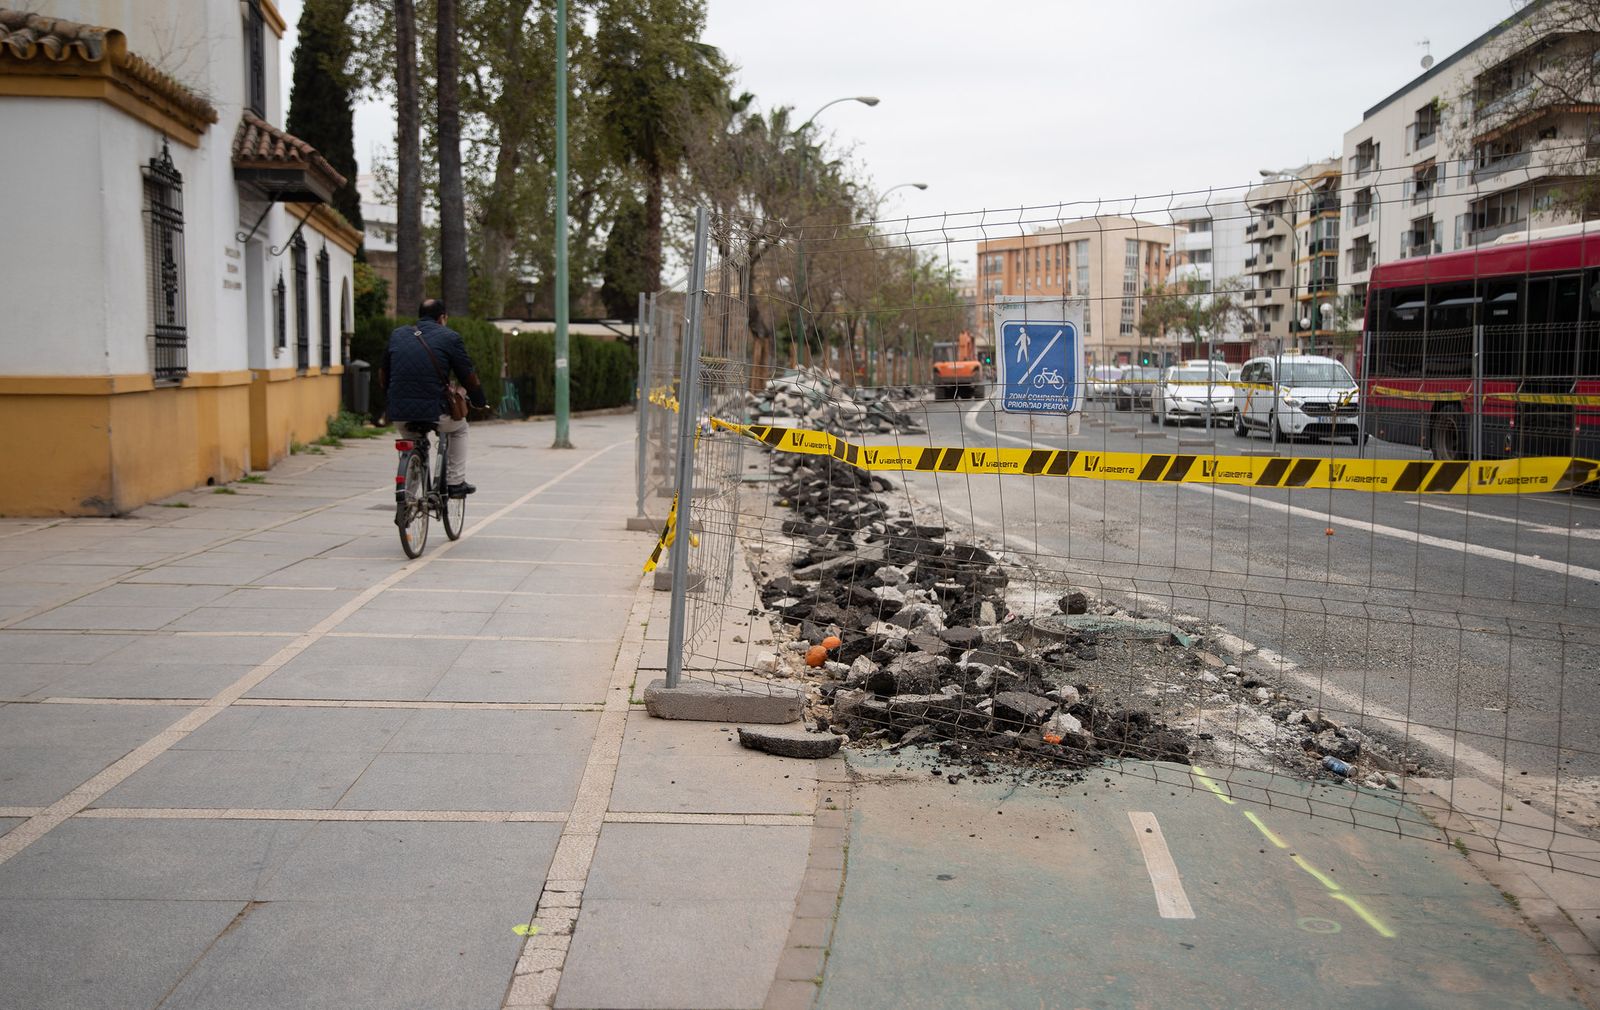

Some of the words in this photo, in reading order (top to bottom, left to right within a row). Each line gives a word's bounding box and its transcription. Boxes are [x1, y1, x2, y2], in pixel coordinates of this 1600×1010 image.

[986, 461, 1018, 469] vialterra
[1099, 466, 1135, 474] vialterra
[1218, 470, 1253, 479] vialterra
[1345, 475, 1388, 484] vialterra
